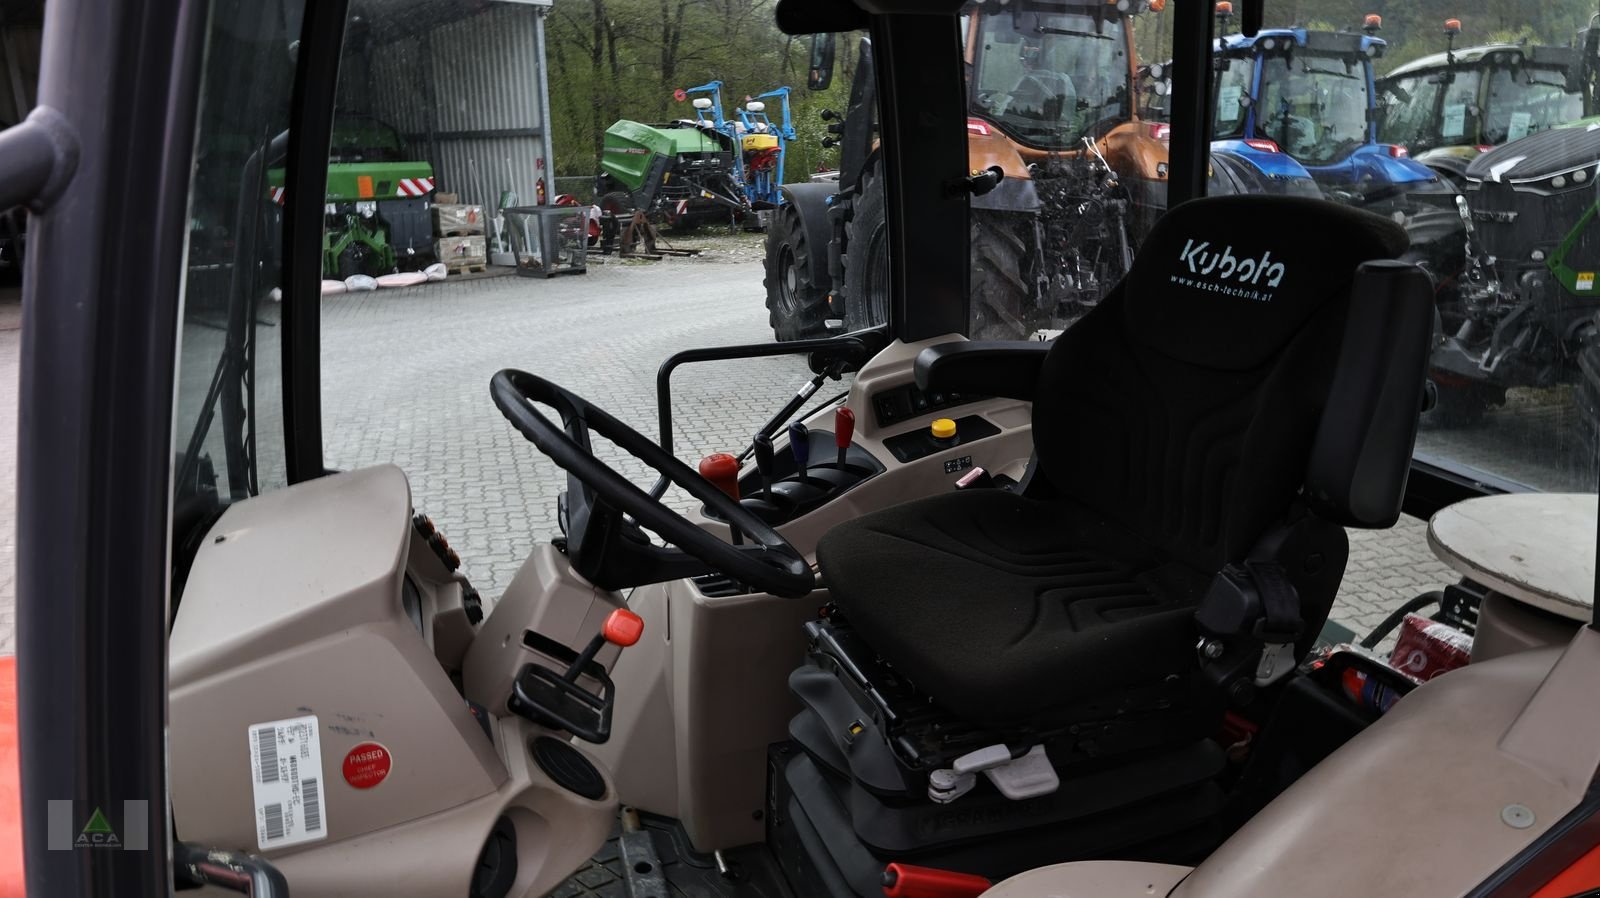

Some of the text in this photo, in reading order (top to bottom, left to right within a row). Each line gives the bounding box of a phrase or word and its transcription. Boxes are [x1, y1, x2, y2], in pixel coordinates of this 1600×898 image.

[1180, 239, 1285, 288] Kubota
[1170, 275, 1273, 302] www.esch-technik.at
[349, 749, 383, 765] PASSED
